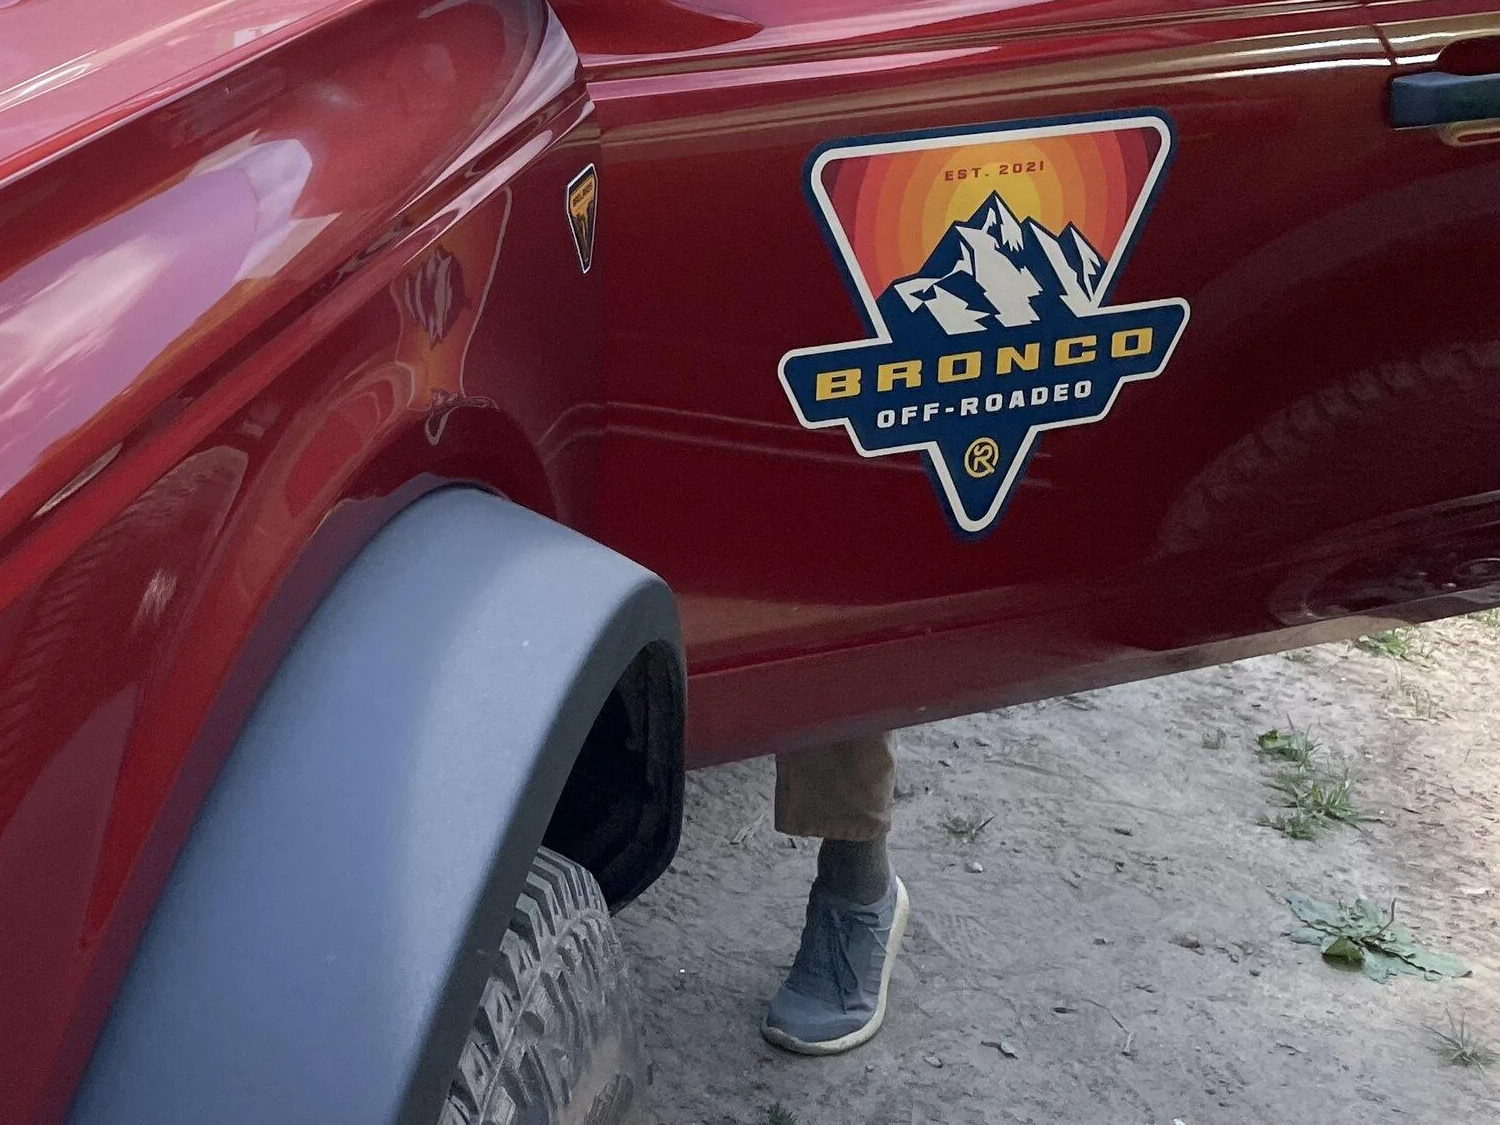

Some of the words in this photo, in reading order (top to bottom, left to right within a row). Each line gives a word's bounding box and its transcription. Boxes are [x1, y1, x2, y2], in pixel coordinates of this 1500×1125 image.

[945, 167, 990, 181] EST.
[999, 161, 1044, 175] 2021
[815, 327, 1154, 401] BRONCO
[877, 380, 1093, 429] OFF-ROADEO
